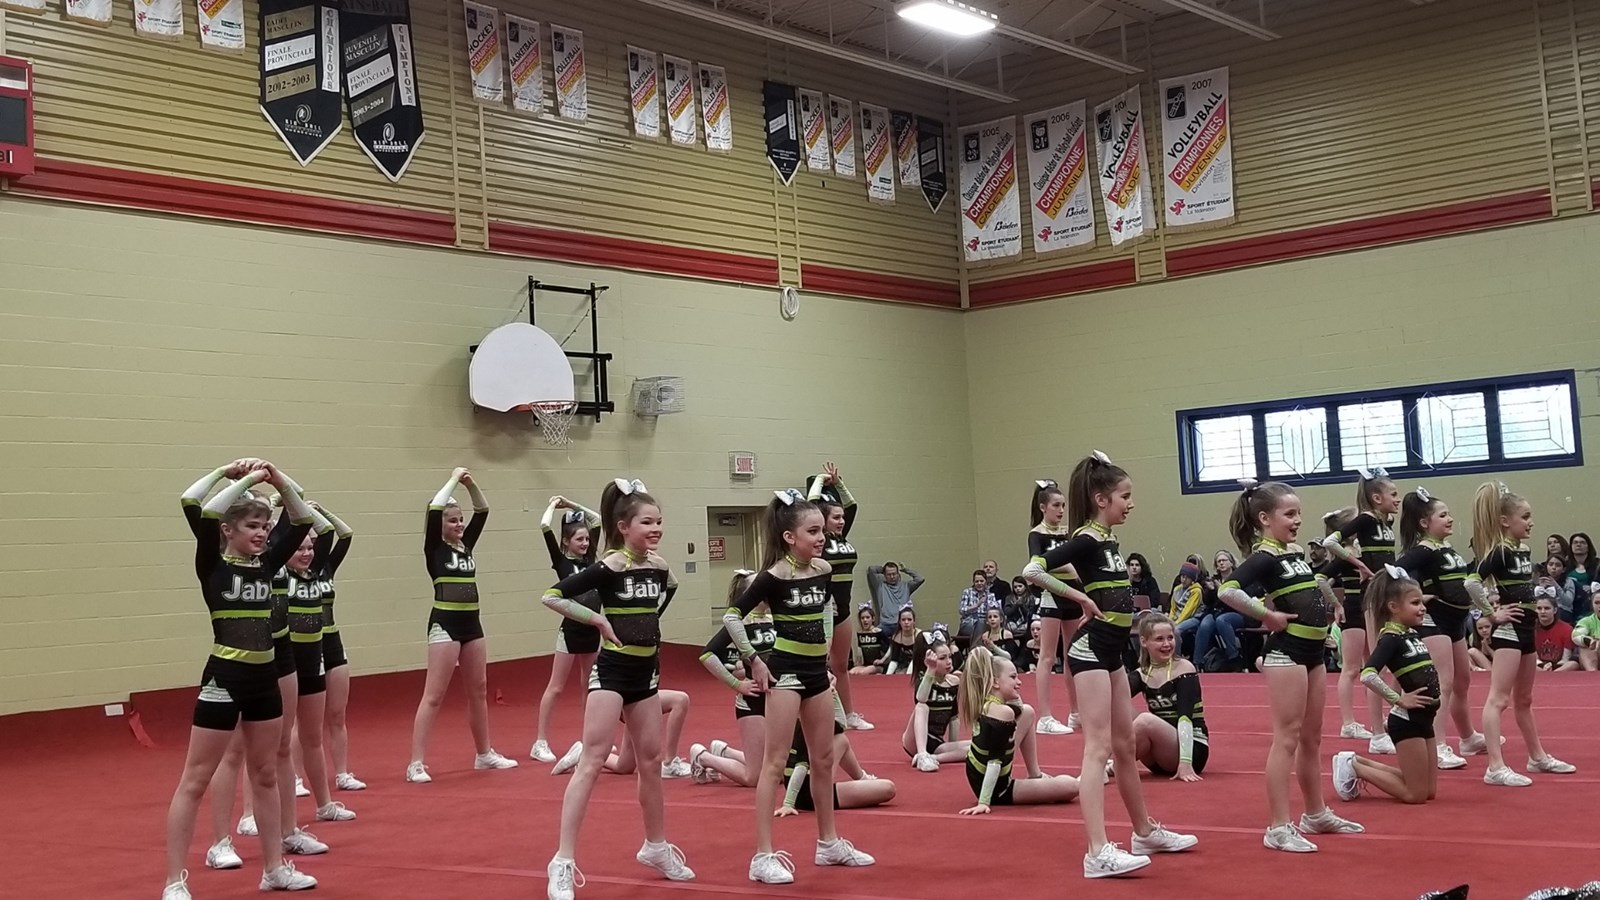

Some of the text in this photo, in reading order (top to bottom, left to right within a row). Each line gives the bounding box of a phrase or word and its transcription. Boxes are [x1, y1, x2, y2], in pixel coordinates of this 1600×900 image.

[266, 20, 303, 34] MASCULIN
[468, 20, 494, 54] HOCKEY
[267, 45, 293, 58] FINALE
[267, 47, 314, 66] PROVINCIALE
[326, 9, 335, 90] CHAMPIONS
[346, 40, 382, 61] MASCULIN
[510, 35, 537, 67] BASKETBALL
[555, 44, 581, 74] VOLLEYBALL
[349, 68, 372, 84] FINALE
[350, 65, 393, 92] PROVINCIALE
[398, 26, 413, 104] CHAMPIONS
[630, 65, 654, 94] BASKETBALL
[1191, 78, 1213, 91] 2007
[353, 96, 385, 118] 2003-2004
[804, 103, 821, 132] HOCKEY
[1050, 112, 1071, 125] 2006
[981, 126, 1001, 138] 2005
[1167, 91, 1223, 159] VOLLEYBALL
[1173, 115, 1225, 181] CHAMPIONNES
[969, 158, 1013, 219] CHAMPIONNE
[1040, 145, 1084, 209] CHAMPIONNE
[1191, 163, 1216, 194] Division
[978, 176, 1015, 226] CADETTE
[1187, 201, 1206, 210] SPORT
[1053, 227, 1070, 236] SPORT
[1125, 215, 1142, 225] SPORT
[981, 238, 998, 246] SPORT
[1280, 557, 1313, 579] Jab
[221, 573, 269, 602] Jab
